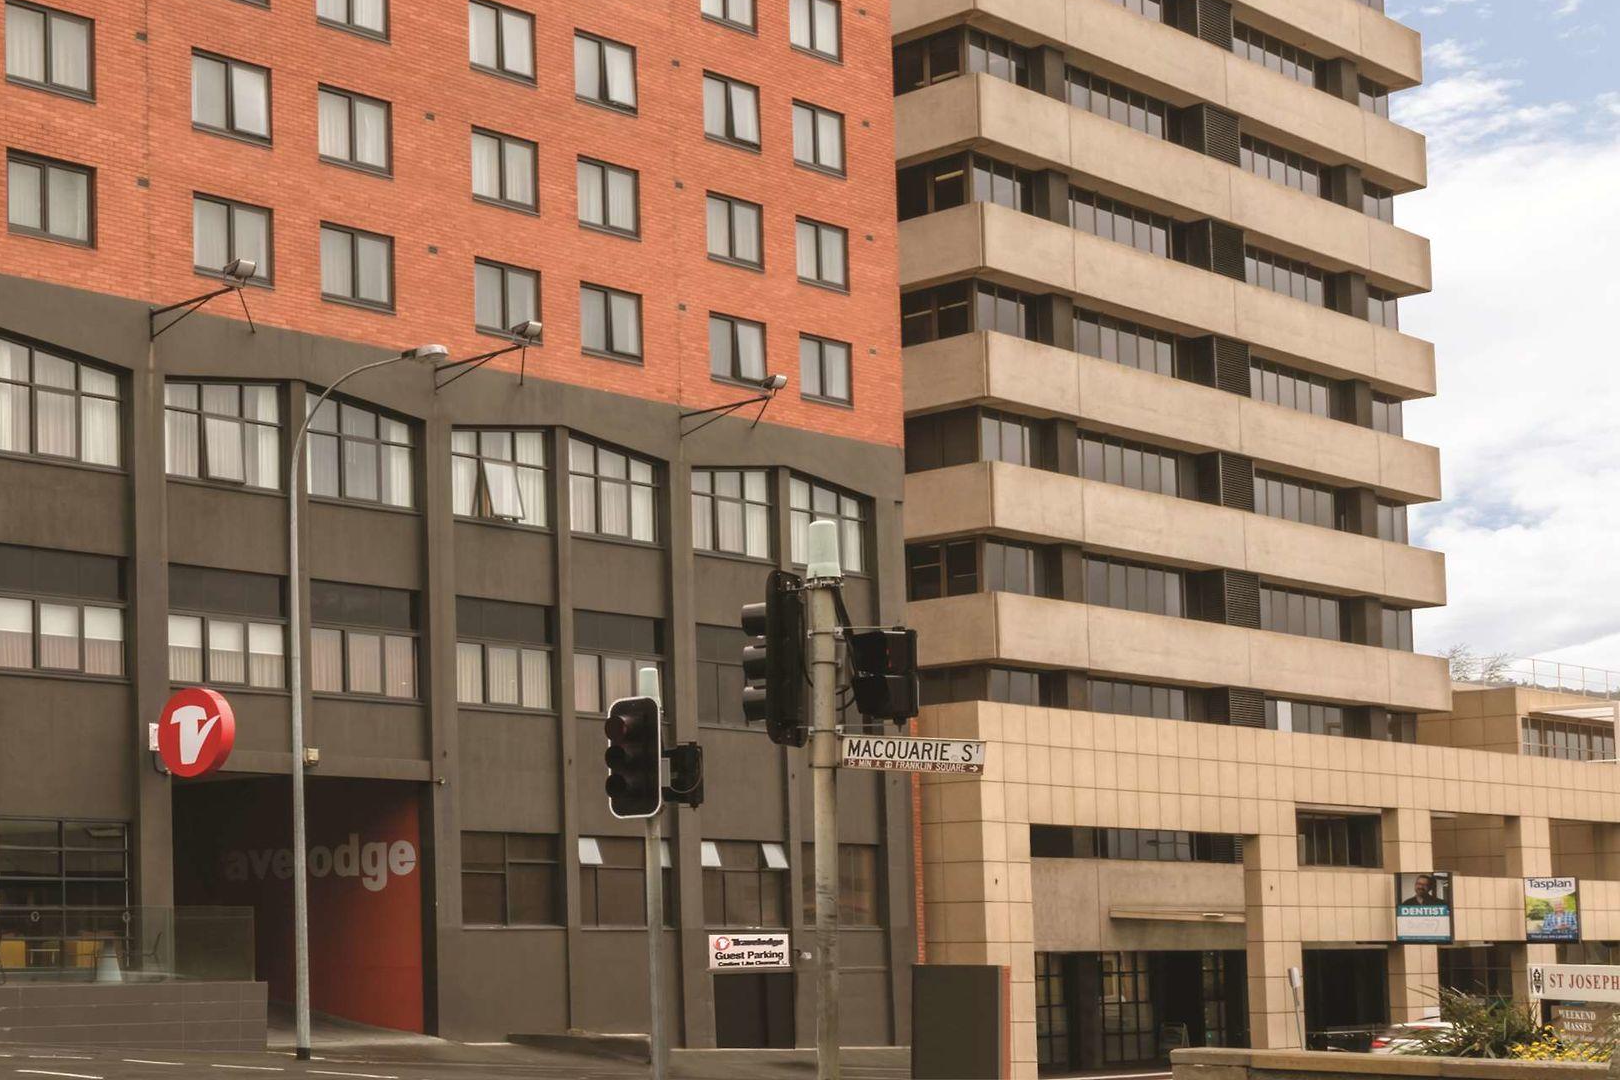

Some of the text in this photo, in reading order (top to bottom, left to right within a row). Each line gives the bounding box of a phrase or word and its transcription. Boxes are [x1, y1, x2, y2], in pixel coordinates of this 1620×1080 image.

[848, 740, 951, 761] MACQUARIE
[859, 760, 872, 768] MIN
[896, 761, 932, 770] FRANKLIN
[936, 763, 966, 772] SQUARE
[1528, 879, 1572, 890] Tasplan
[1401, 907, 1444, 915] DENTIST
[715, 950, 784, 960] Guest Parking
[1549, 974, 1564, 988] ST
[1559, 1010, 1596, 1021] WEEKEND
[1564, 1021, 1593, 1032] MASSES
